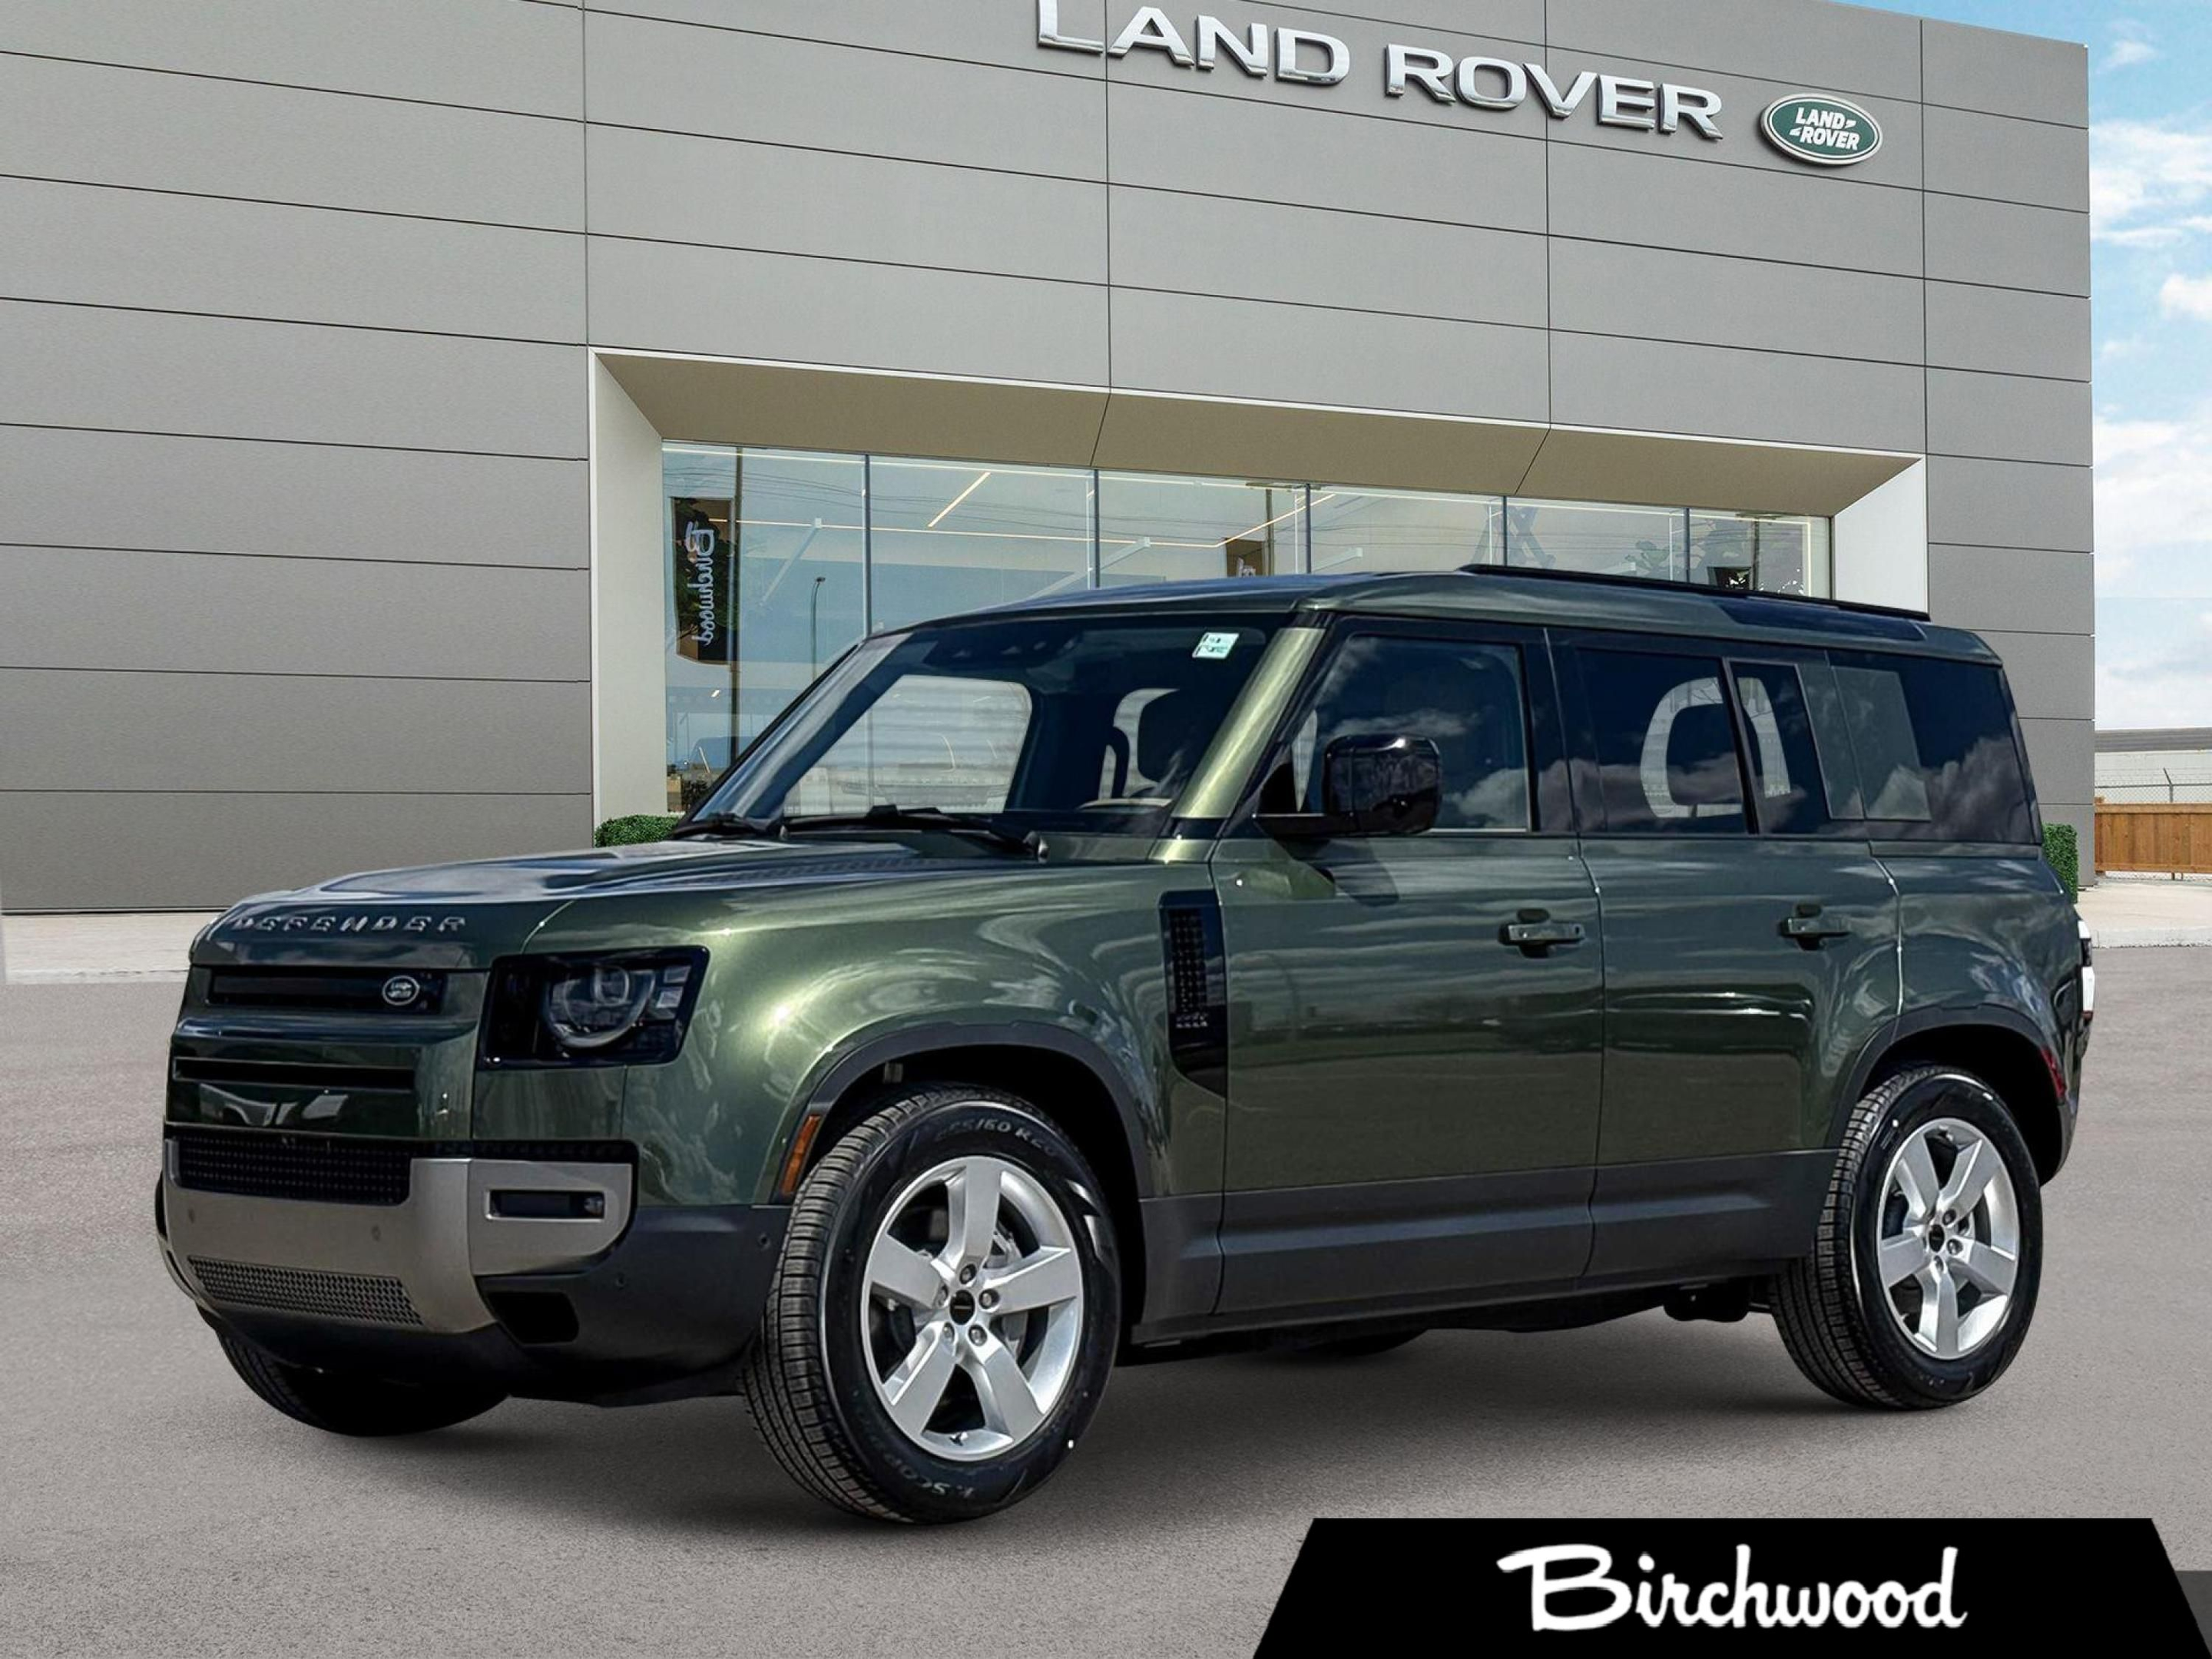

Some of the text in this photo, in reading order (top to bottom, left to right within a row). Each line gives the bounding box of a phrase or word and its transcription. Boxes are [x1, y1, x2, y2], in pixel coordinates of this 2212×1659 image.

[1037, 0, 1724, 141] LAND ROVER
[1795, 107, 1846, 130] LAND
[1799, 125, 1860, 151] ROVER
